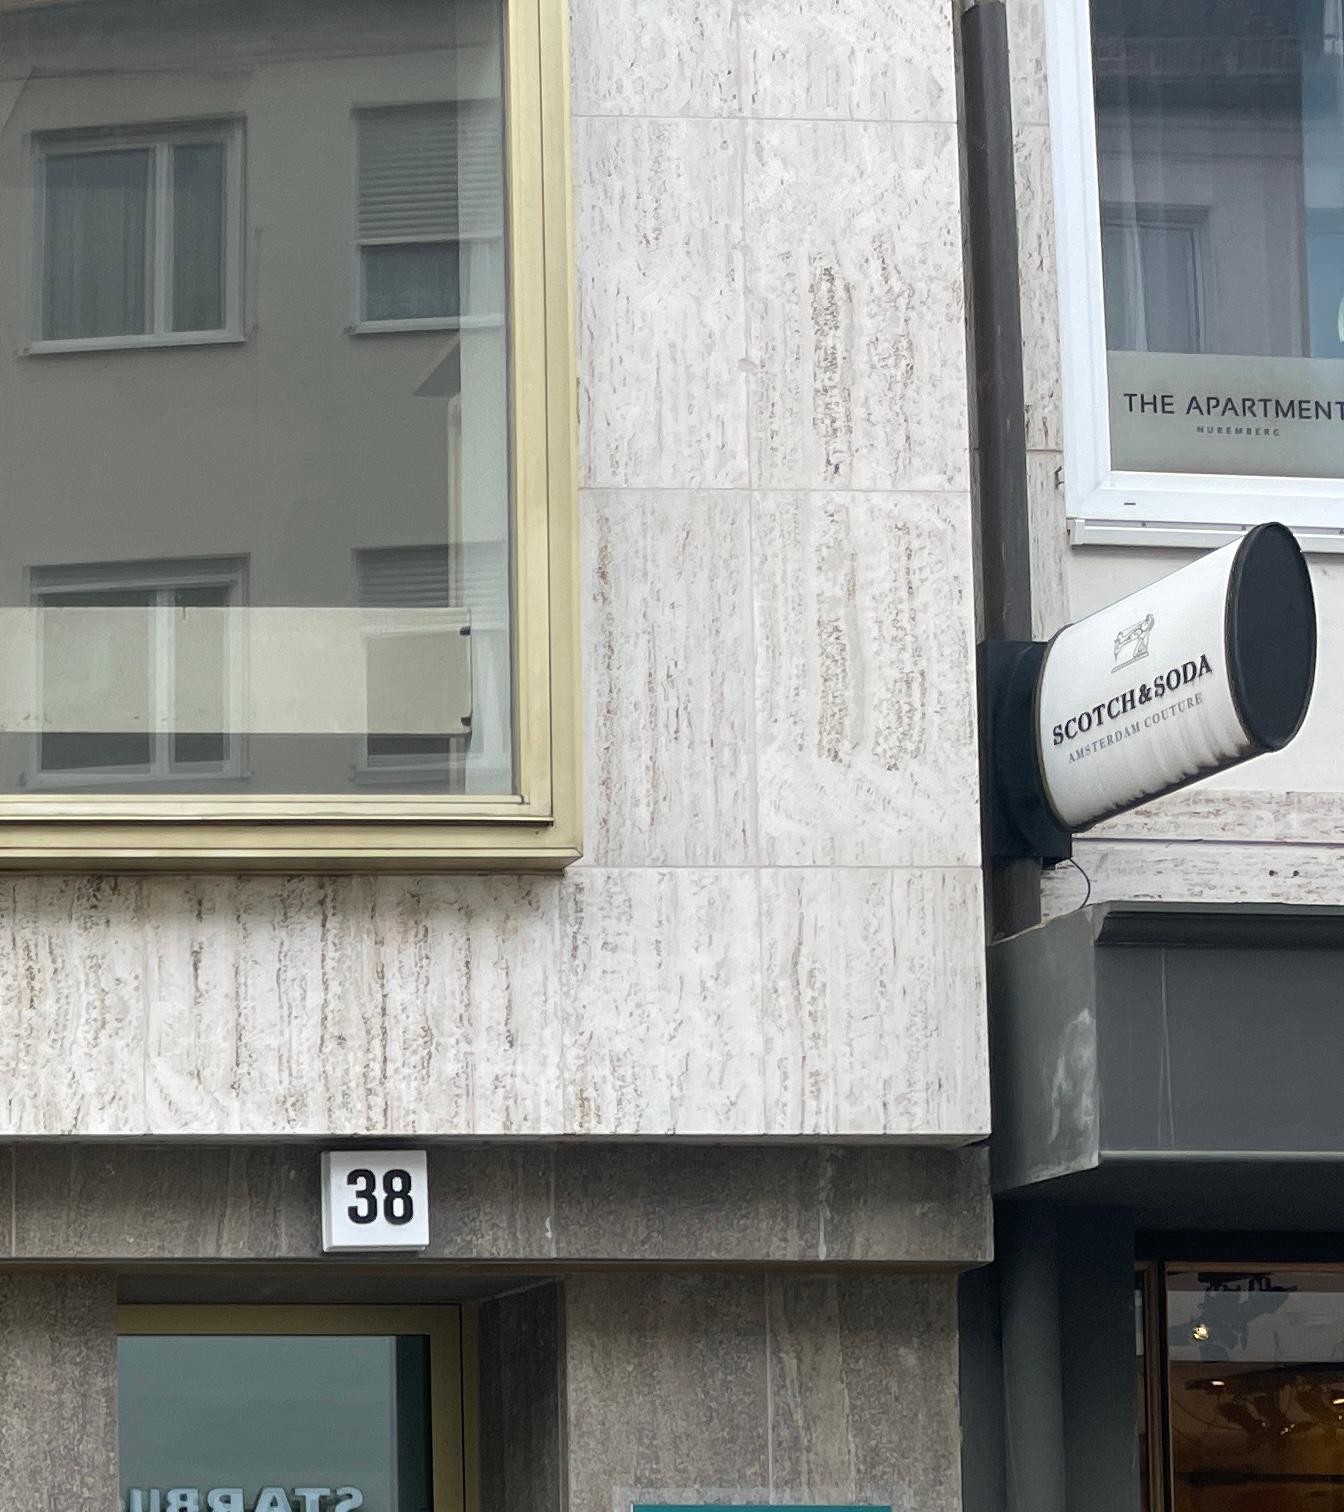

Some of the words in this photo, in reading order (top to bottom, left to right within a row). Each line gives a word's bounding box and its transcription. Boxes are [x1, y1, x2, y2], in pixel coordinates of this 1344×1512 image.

[1123, 393, 1175, 415] THE
[1186, 395, 1344, 420] APARTMENT
[1197, 425, 1280, 437] NUREMBERG
[1052, 654, 1213, 746] SCOTCH&SODA
[1068, 722, 1141, 764] AMSTERDAM
[1144, 693, 1203, 729] COUTURE
[346, 1168, 414, 1226] 38
